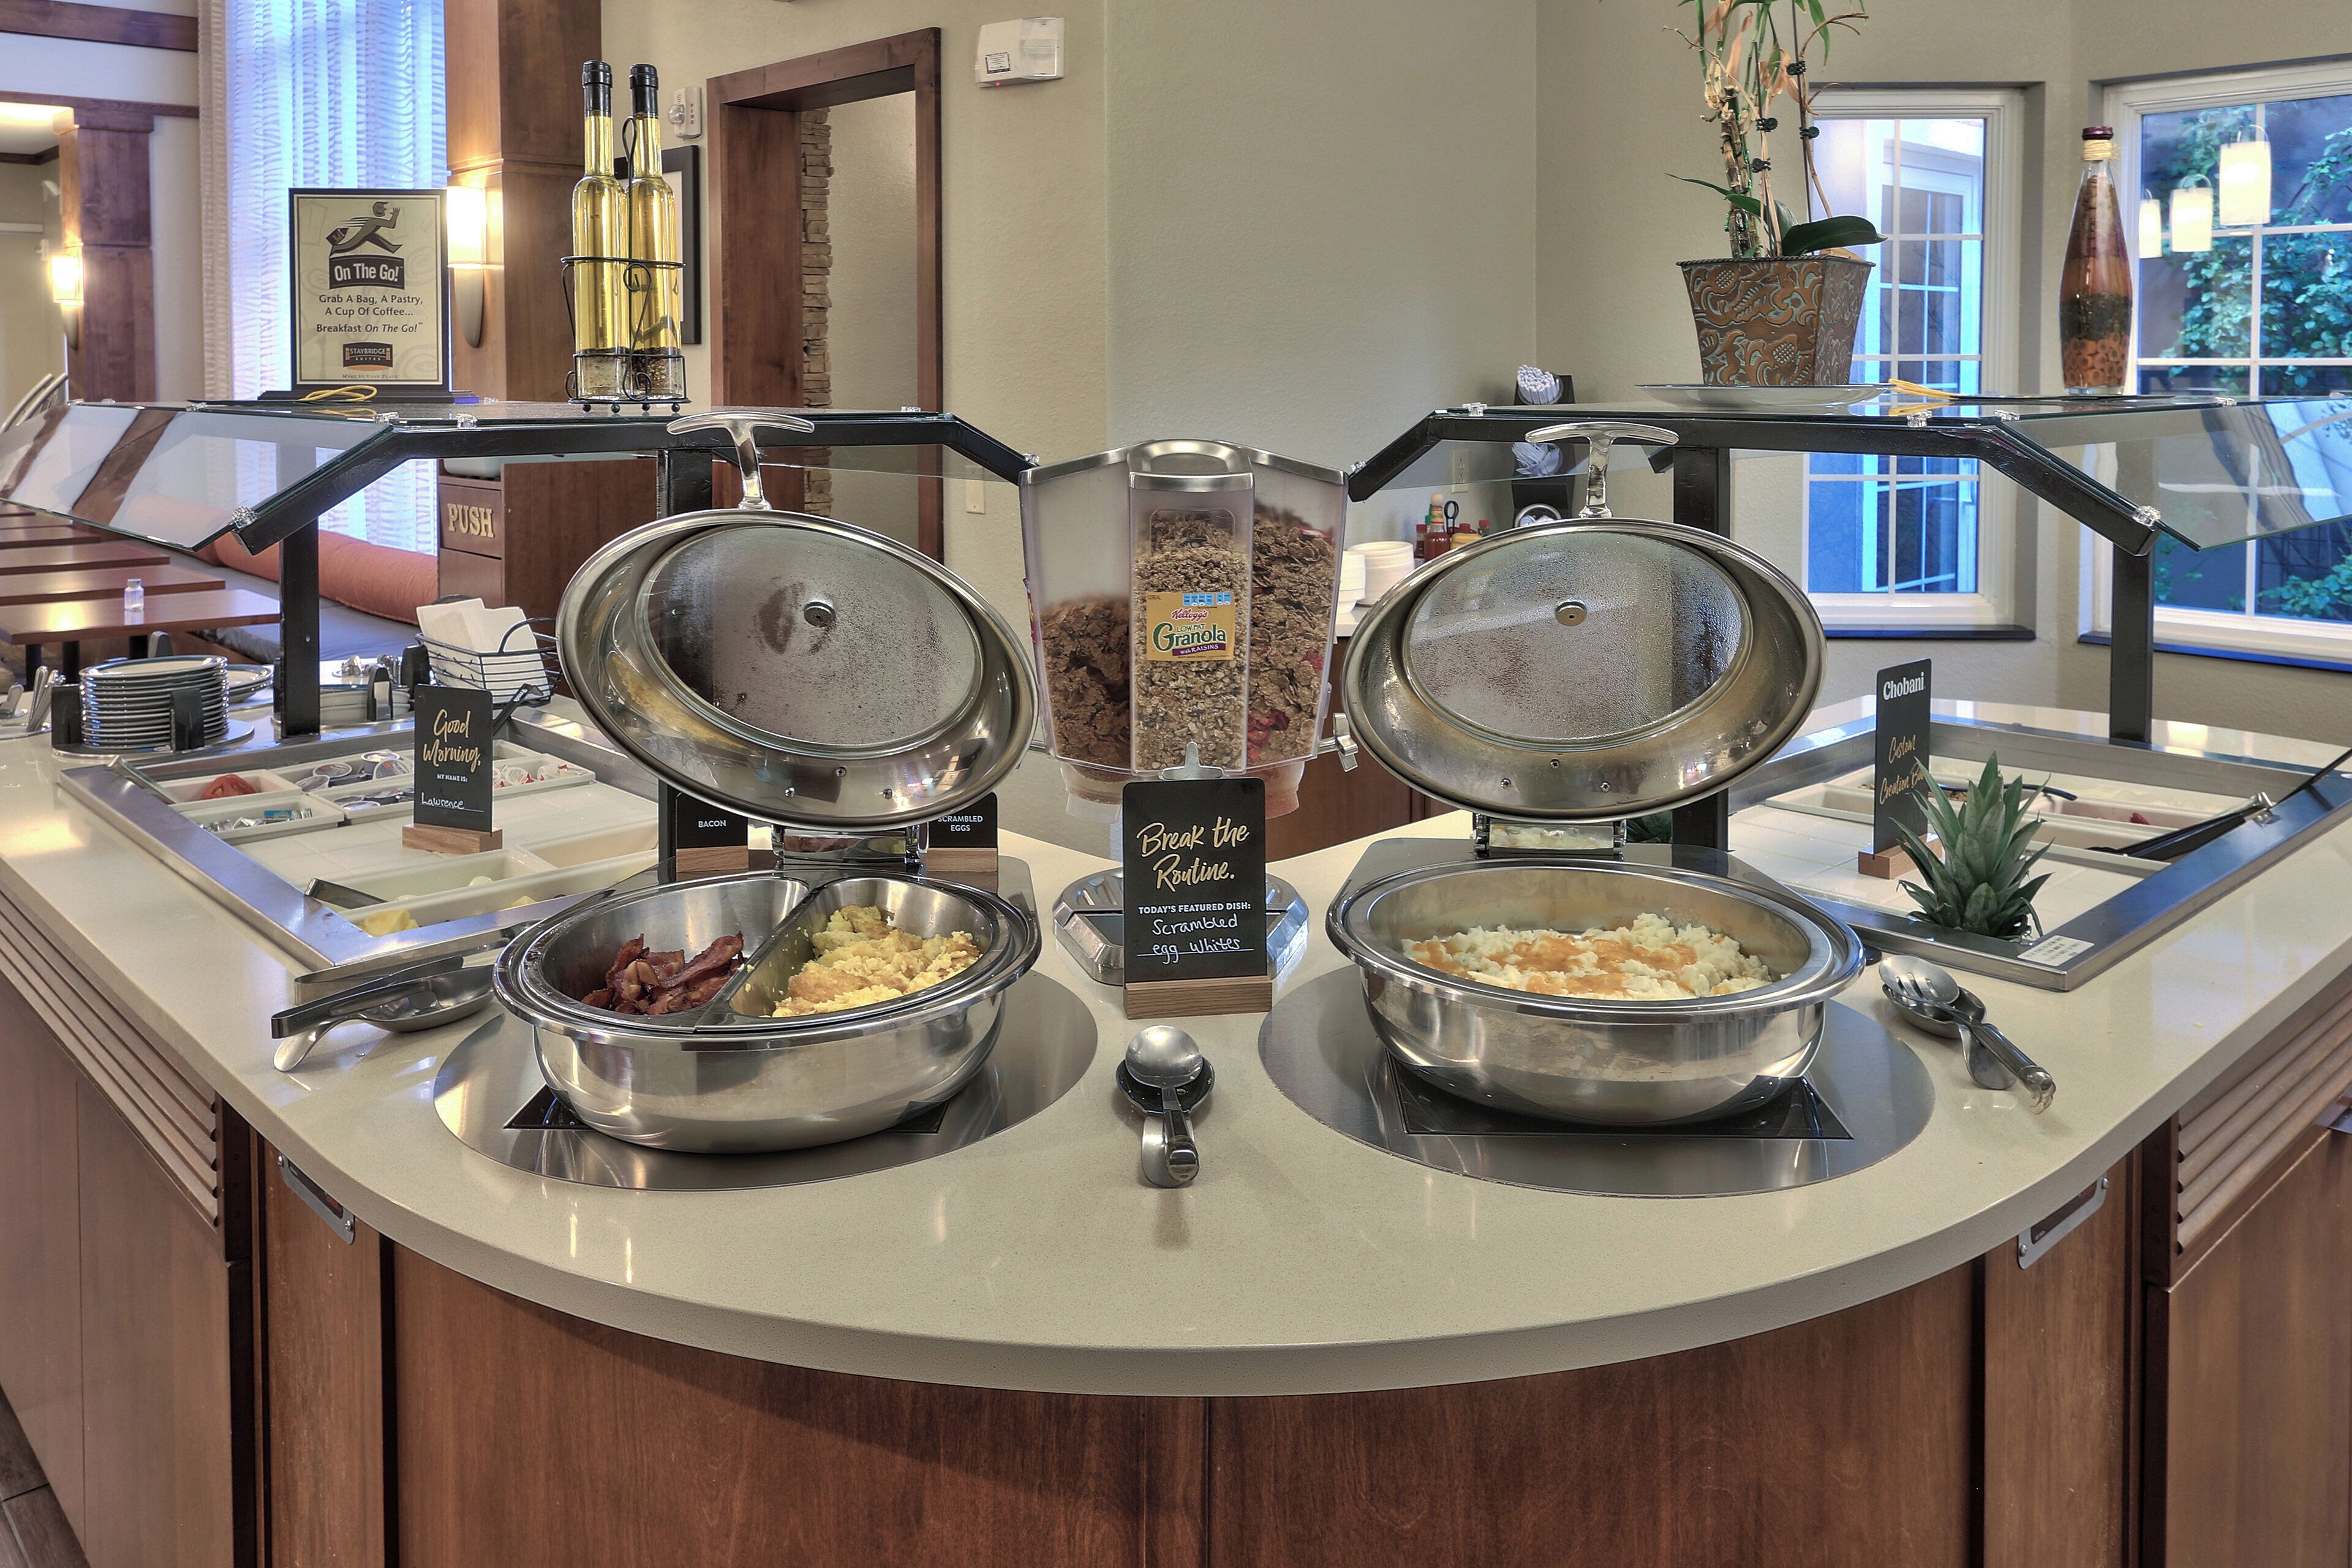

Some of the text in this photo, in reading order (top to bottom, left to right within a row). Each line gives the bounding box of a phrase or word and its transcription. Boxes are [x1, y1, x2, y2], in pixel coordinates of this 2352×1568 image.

[334, 265, 352, 282] On
[353, 262, 377, 279] The
[319, 295, 343, 303] Grab
[356, 295, 378, 306] Bag,
[391, 295, 423, 306] Pastry,
[335, 307, 355, 318] Cup
[358, 307, 370, 315] Of
[372, 307, 413, 315] Coffee...
[317, 323, 361, 333] Breakfast
[365, 324, 379, 333] On
[382, 324, 399, 333] The
[447, 503, 495, 538] PUSH
[1171, 608, 1209, 622] Kellogg's
[1153, 622, 1227, 652] Granola
[1191, 644, 1219, 653] RAISINS
[1883, 671, 1924, 700] Chobani
[433, 708, 472, 742] Good
[423, 739, 481, 773] Morning,
[421, 792, 466, 810] Lawrence
[698, 820, 727, 828] BACON
[1136, 816, 1250, 858] Break the
[1152, 853, 1235, 892] Routine.
[1138, 902, 1251, 914] TODAY'S FEATURED DISH:
[1152, 913, 1238, 935] Scrambled
[1152, 944, 1180, 965] egg
